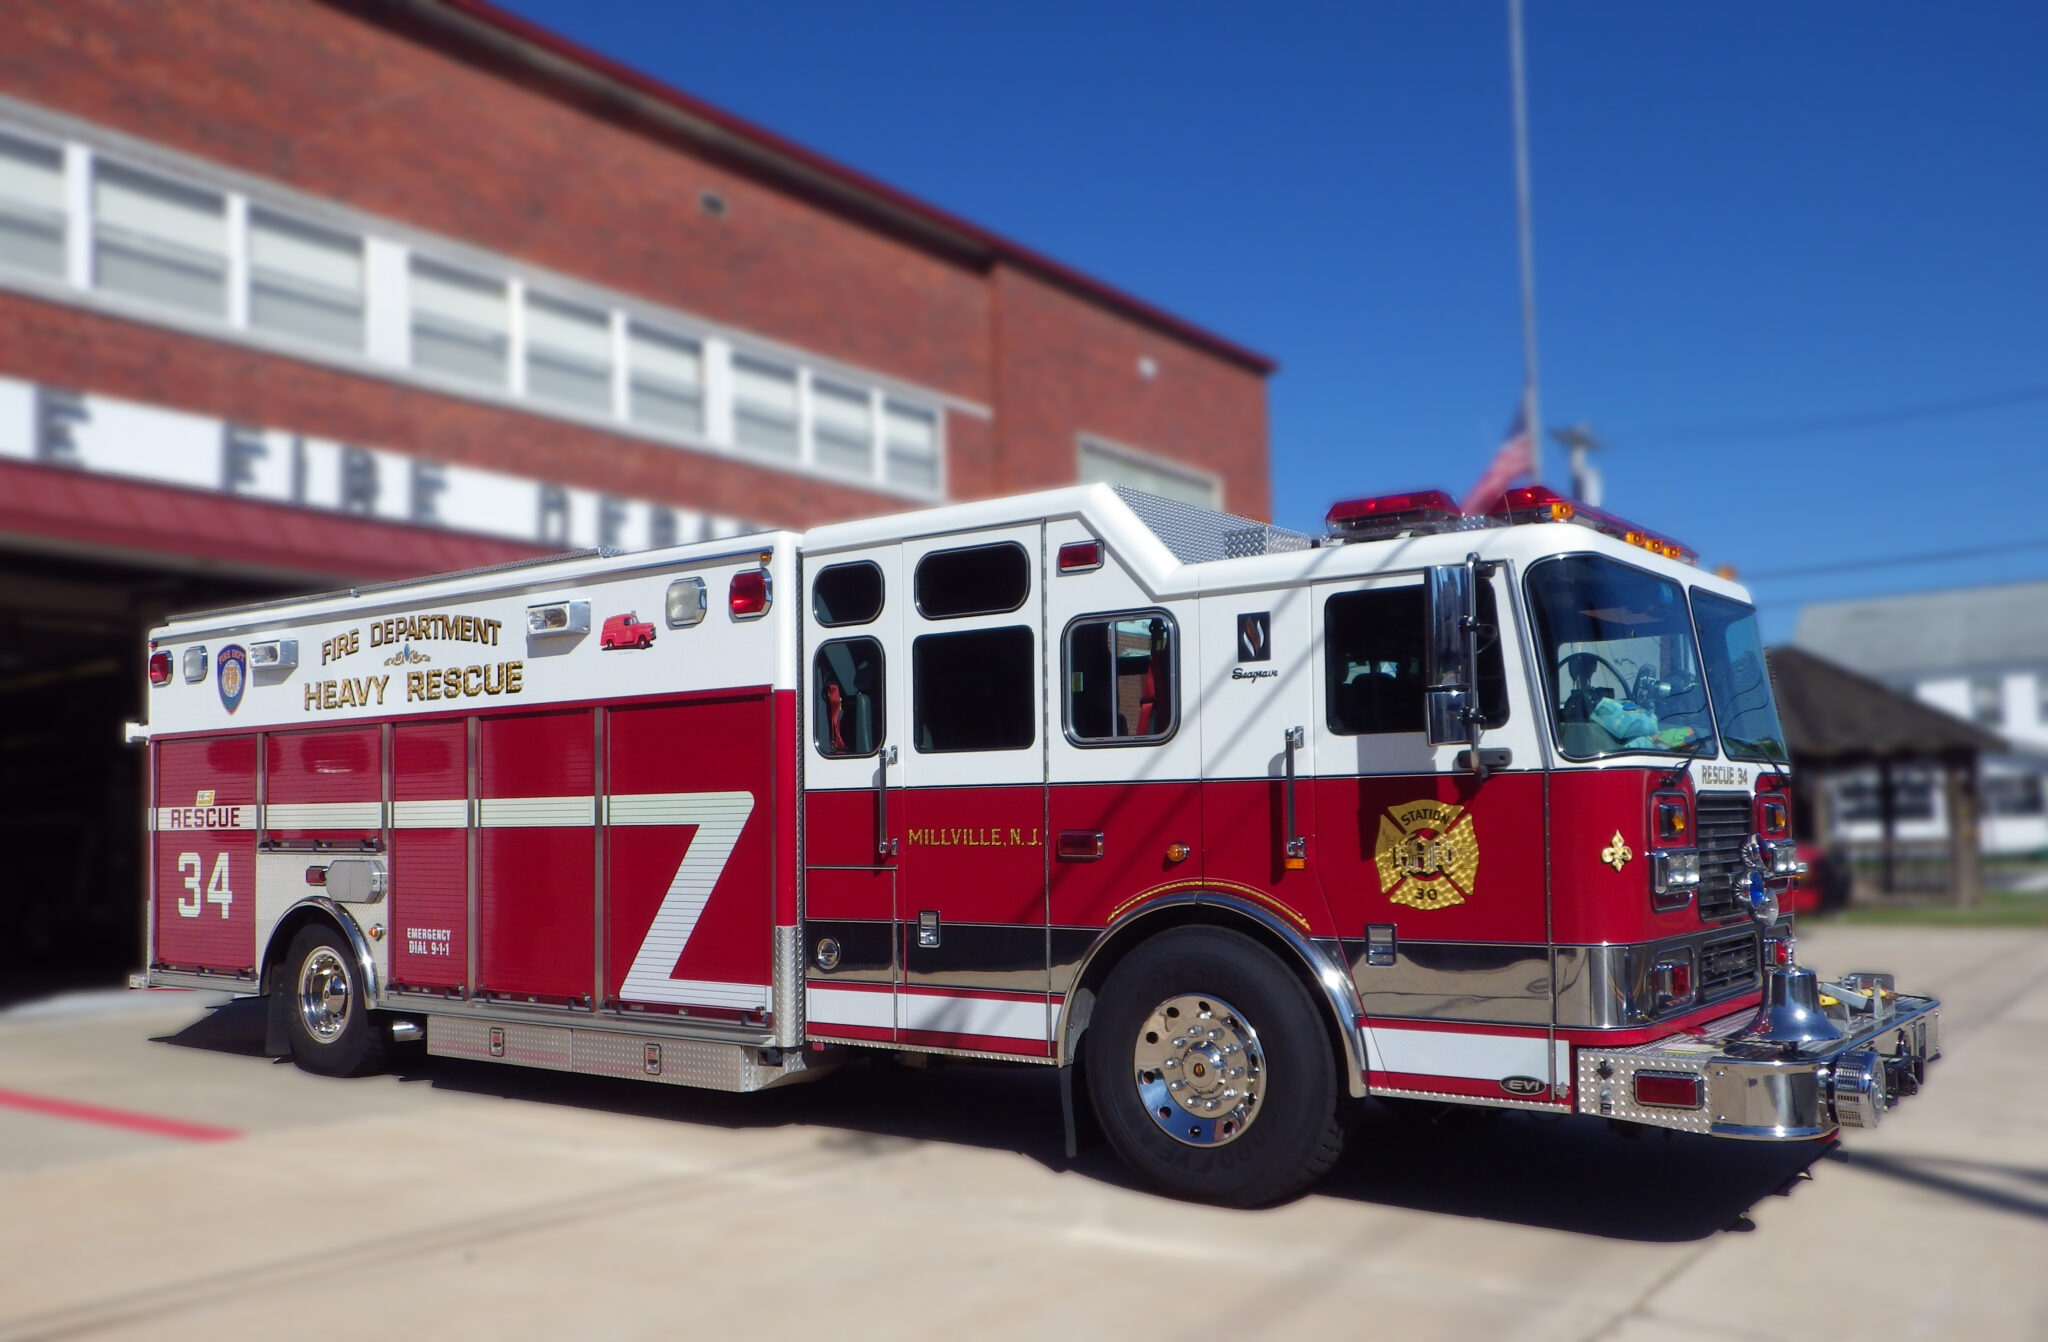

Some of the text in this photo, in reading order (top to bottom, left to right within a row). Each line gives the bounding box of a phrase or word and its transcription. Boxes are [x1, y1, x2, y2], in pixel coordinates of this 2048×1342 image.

[321, 614, 502, 666] FIRE DEPARTMENT
[304, 660, 524, 711] HEAVY RESCUE
[1701, 765, 1748, 785] RESCUE 34
[170, 807, 241, 828] RESCUE
[1400, 807, 1451, 827] STATION
[908, 828, 1007, 848] MILLVILLE,
[178, 852, 233, 919] 34
[1415, 888, 1438, 901] 30
[406, 927, 451, 941] EMERGENCY
[408, 940, 428, 955] DIAL
[1509, 1079, 1540, 1091] EVI
